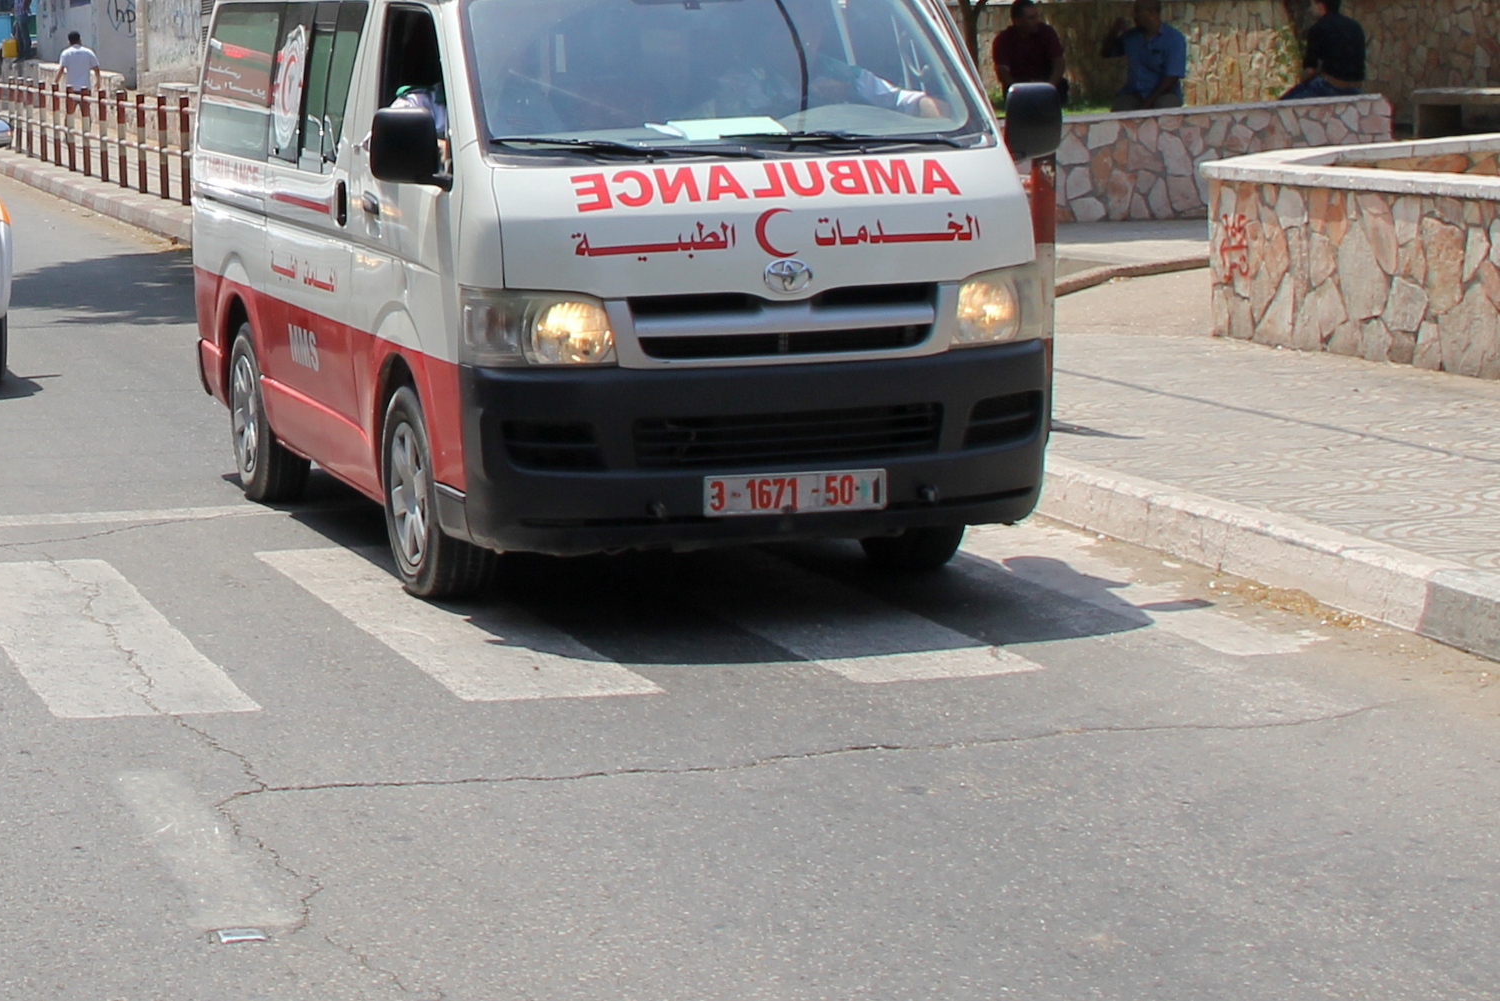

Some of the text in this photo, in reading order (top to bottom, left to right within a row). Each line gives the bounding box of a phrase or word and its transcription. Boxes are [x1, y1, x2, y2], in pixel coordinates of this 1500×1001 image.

[571, 212, 981, 262] الخدمات الطبية
[287, 322, 320, 373] MMS
